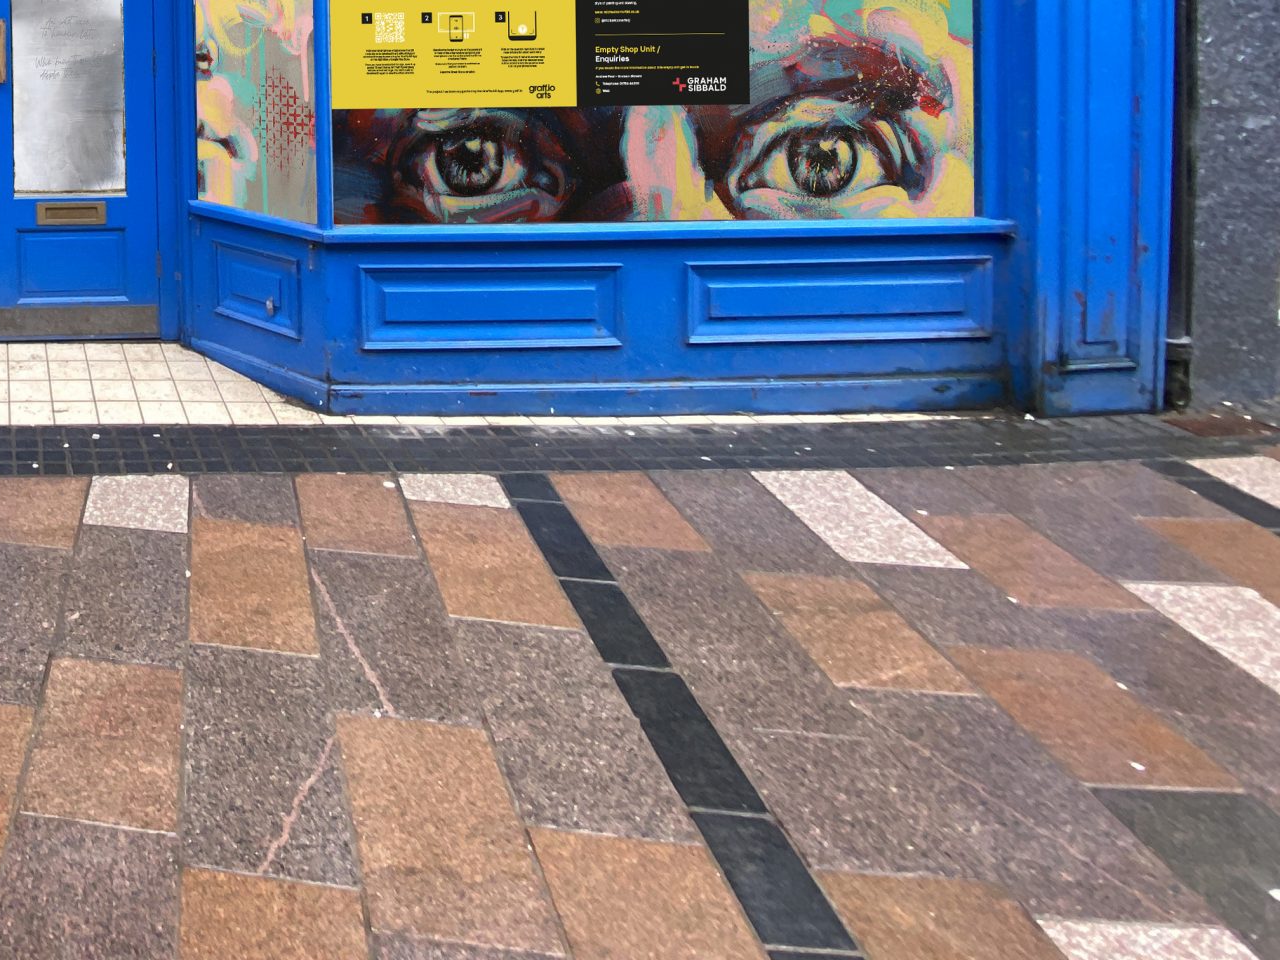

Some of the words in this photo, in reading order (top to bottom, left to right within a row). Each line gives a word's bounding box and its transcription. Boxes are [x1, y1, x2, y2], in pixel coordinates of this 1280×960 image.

[595, 46, 619, 54] Empty
[620, 46, 639, 54] Shop
[595, 55, 630, 63] Enquiries
[688, 84, 727, 92] SIBBALD
[536, 90, 551, 99] arts
